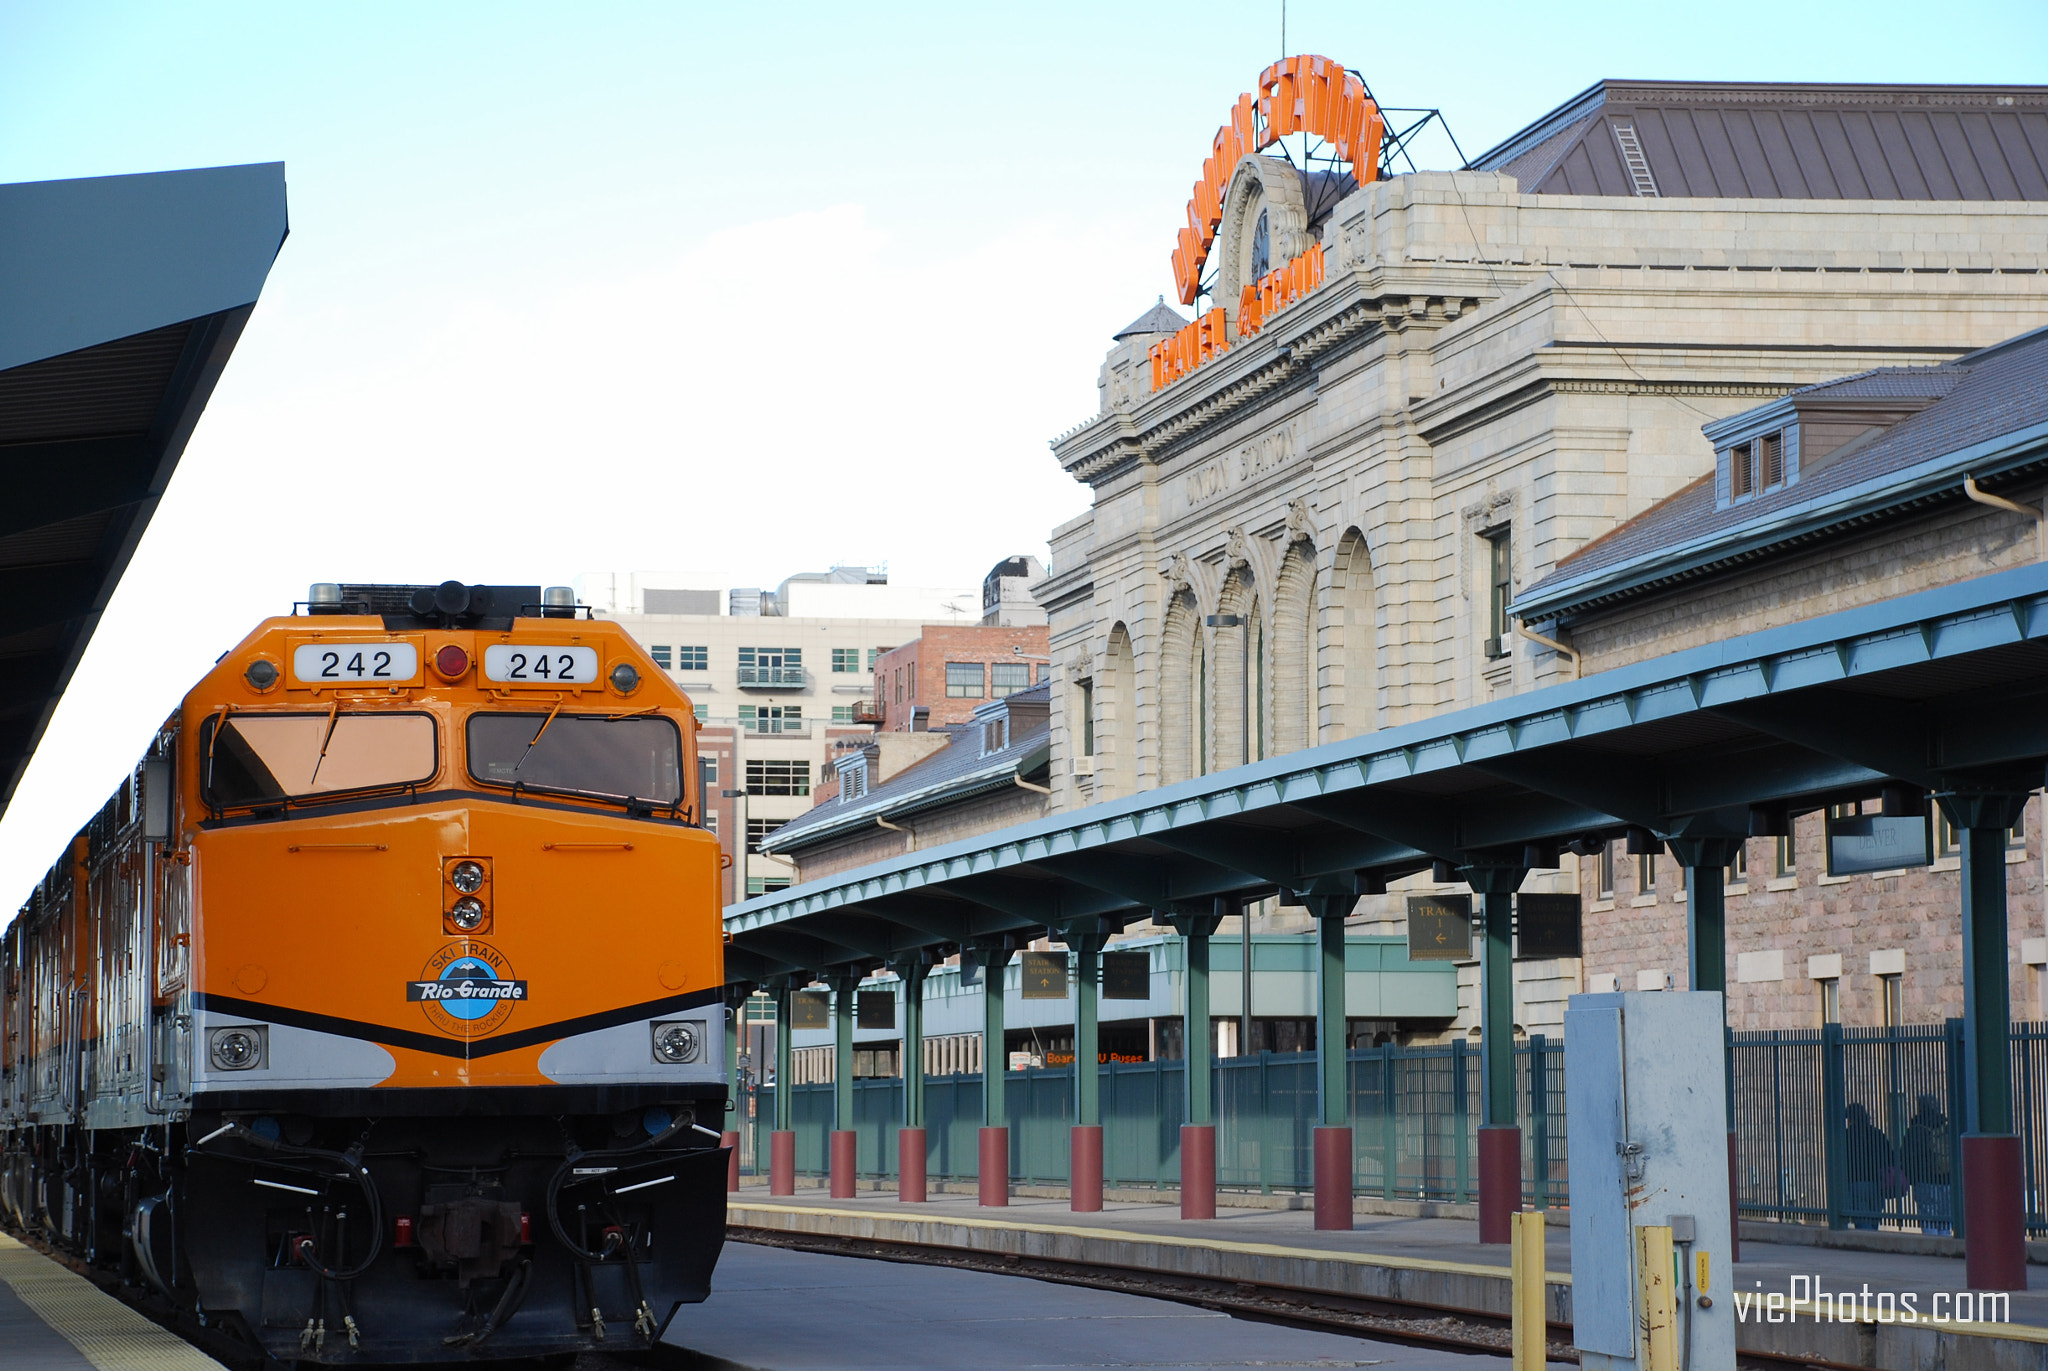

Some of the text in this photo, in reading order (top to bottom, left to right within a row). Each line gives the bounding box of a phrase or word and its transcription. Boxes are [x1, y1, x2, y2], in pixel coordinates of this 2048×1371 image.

[1171, 54, 1384, 305] UNION STATION
[1148, 307, 1230, 393] TRAVEL
[1257, 242, 1325, 313] TRAIN
[1187, 423, 1297, 506] UNION STATION
[321, 651, 392, 677] 242
[510, 653, 575, 680] 242
[1859, 827, 1897, 850] DENVER
[431, 943, 503, 970] SKI TRAIN
[1029, 967, 1061, 975] STATION
[415, 980, 523, 999] Rio Grande
[428, 1003, 508, 1033] THRU THE ROCKIES
[1047, 1052, 1076, 1064] Boar
